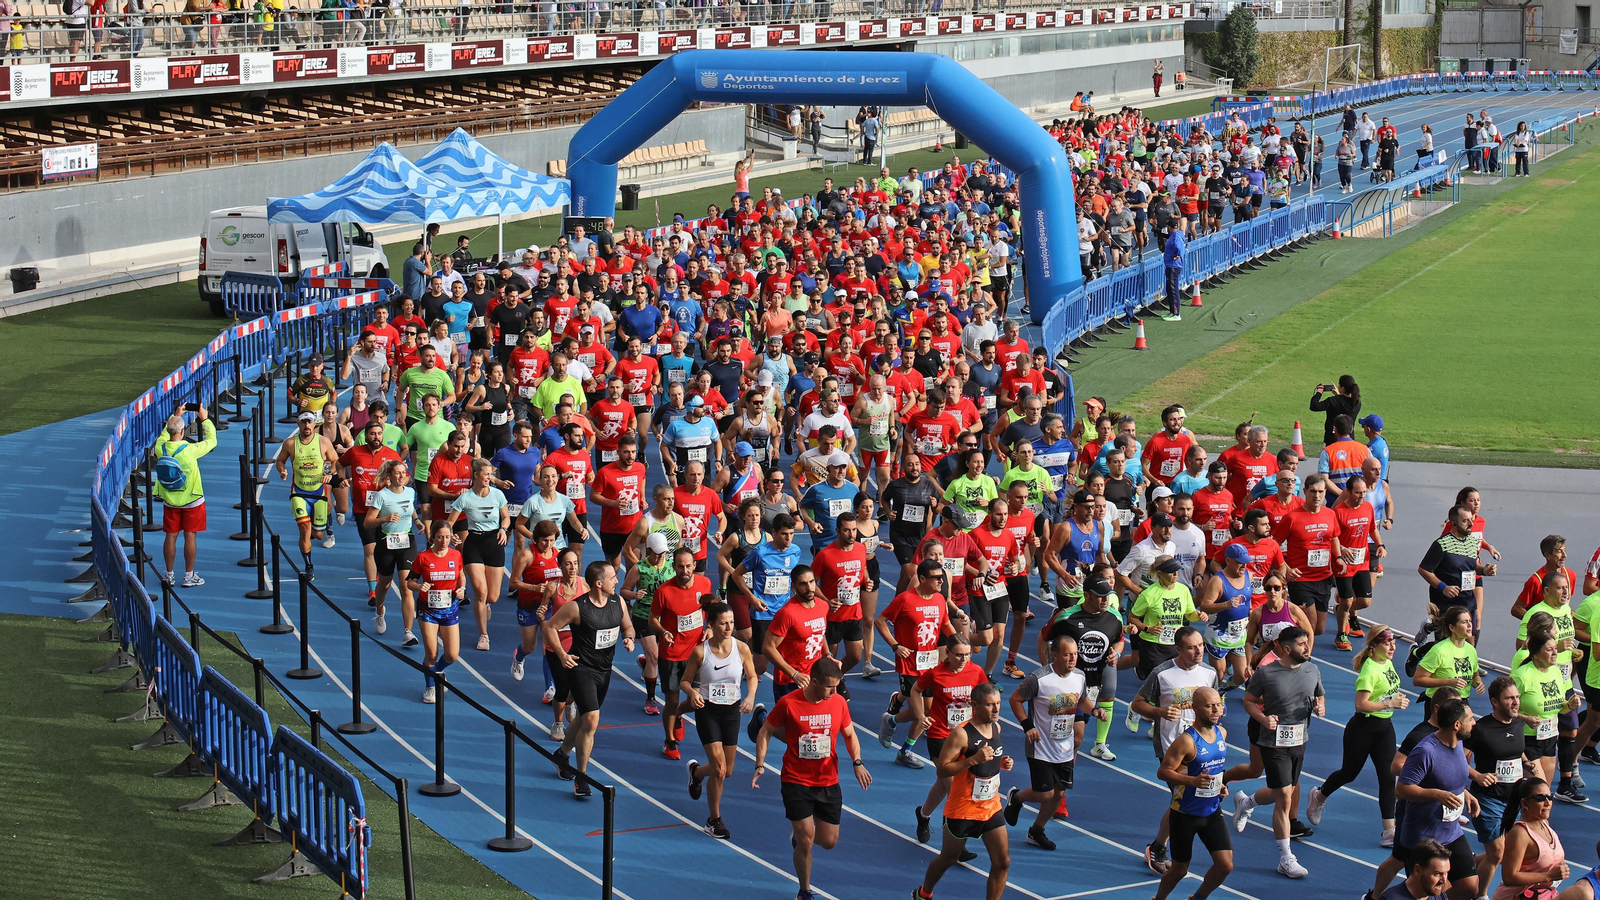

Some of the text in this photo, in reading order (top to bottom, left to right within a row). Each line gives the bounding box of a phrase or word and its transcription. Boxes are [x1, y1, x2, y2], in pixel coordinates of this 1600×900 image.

[598, 40, 616, 50] PLAY
[530, 44, 548, 54] PLAY
[544, 42, 568, 59] JEREZ
[454, 49, 474, 60] PLAY
[470, 47, 496, 64] JEREZ
[370, 52, 416, 70] PLAY JEREZ
[276, 58, 328, 77] PLAY JEREZ
[172, 63, 229, 84] PLAY JEREZ
[55, 70, 118, 92] PLAY JEREZ
[722, 74, 833, 83] Ayuntamiento
[860, 76, 900, 85] Jerez
[680, 618, 692, 626] 338
[598, 634, 611, 642] 163
[918, 655, 929, 663] 681
[712, 688, 726, 697] 245
[950, 714, 964, 722] 496
[1053, 723, 1066, 732] 548
[1280, 731, 1294, 739] 393
[802, 744, 817, 752] 133
[1496, 766, 1514, 775] 1007
